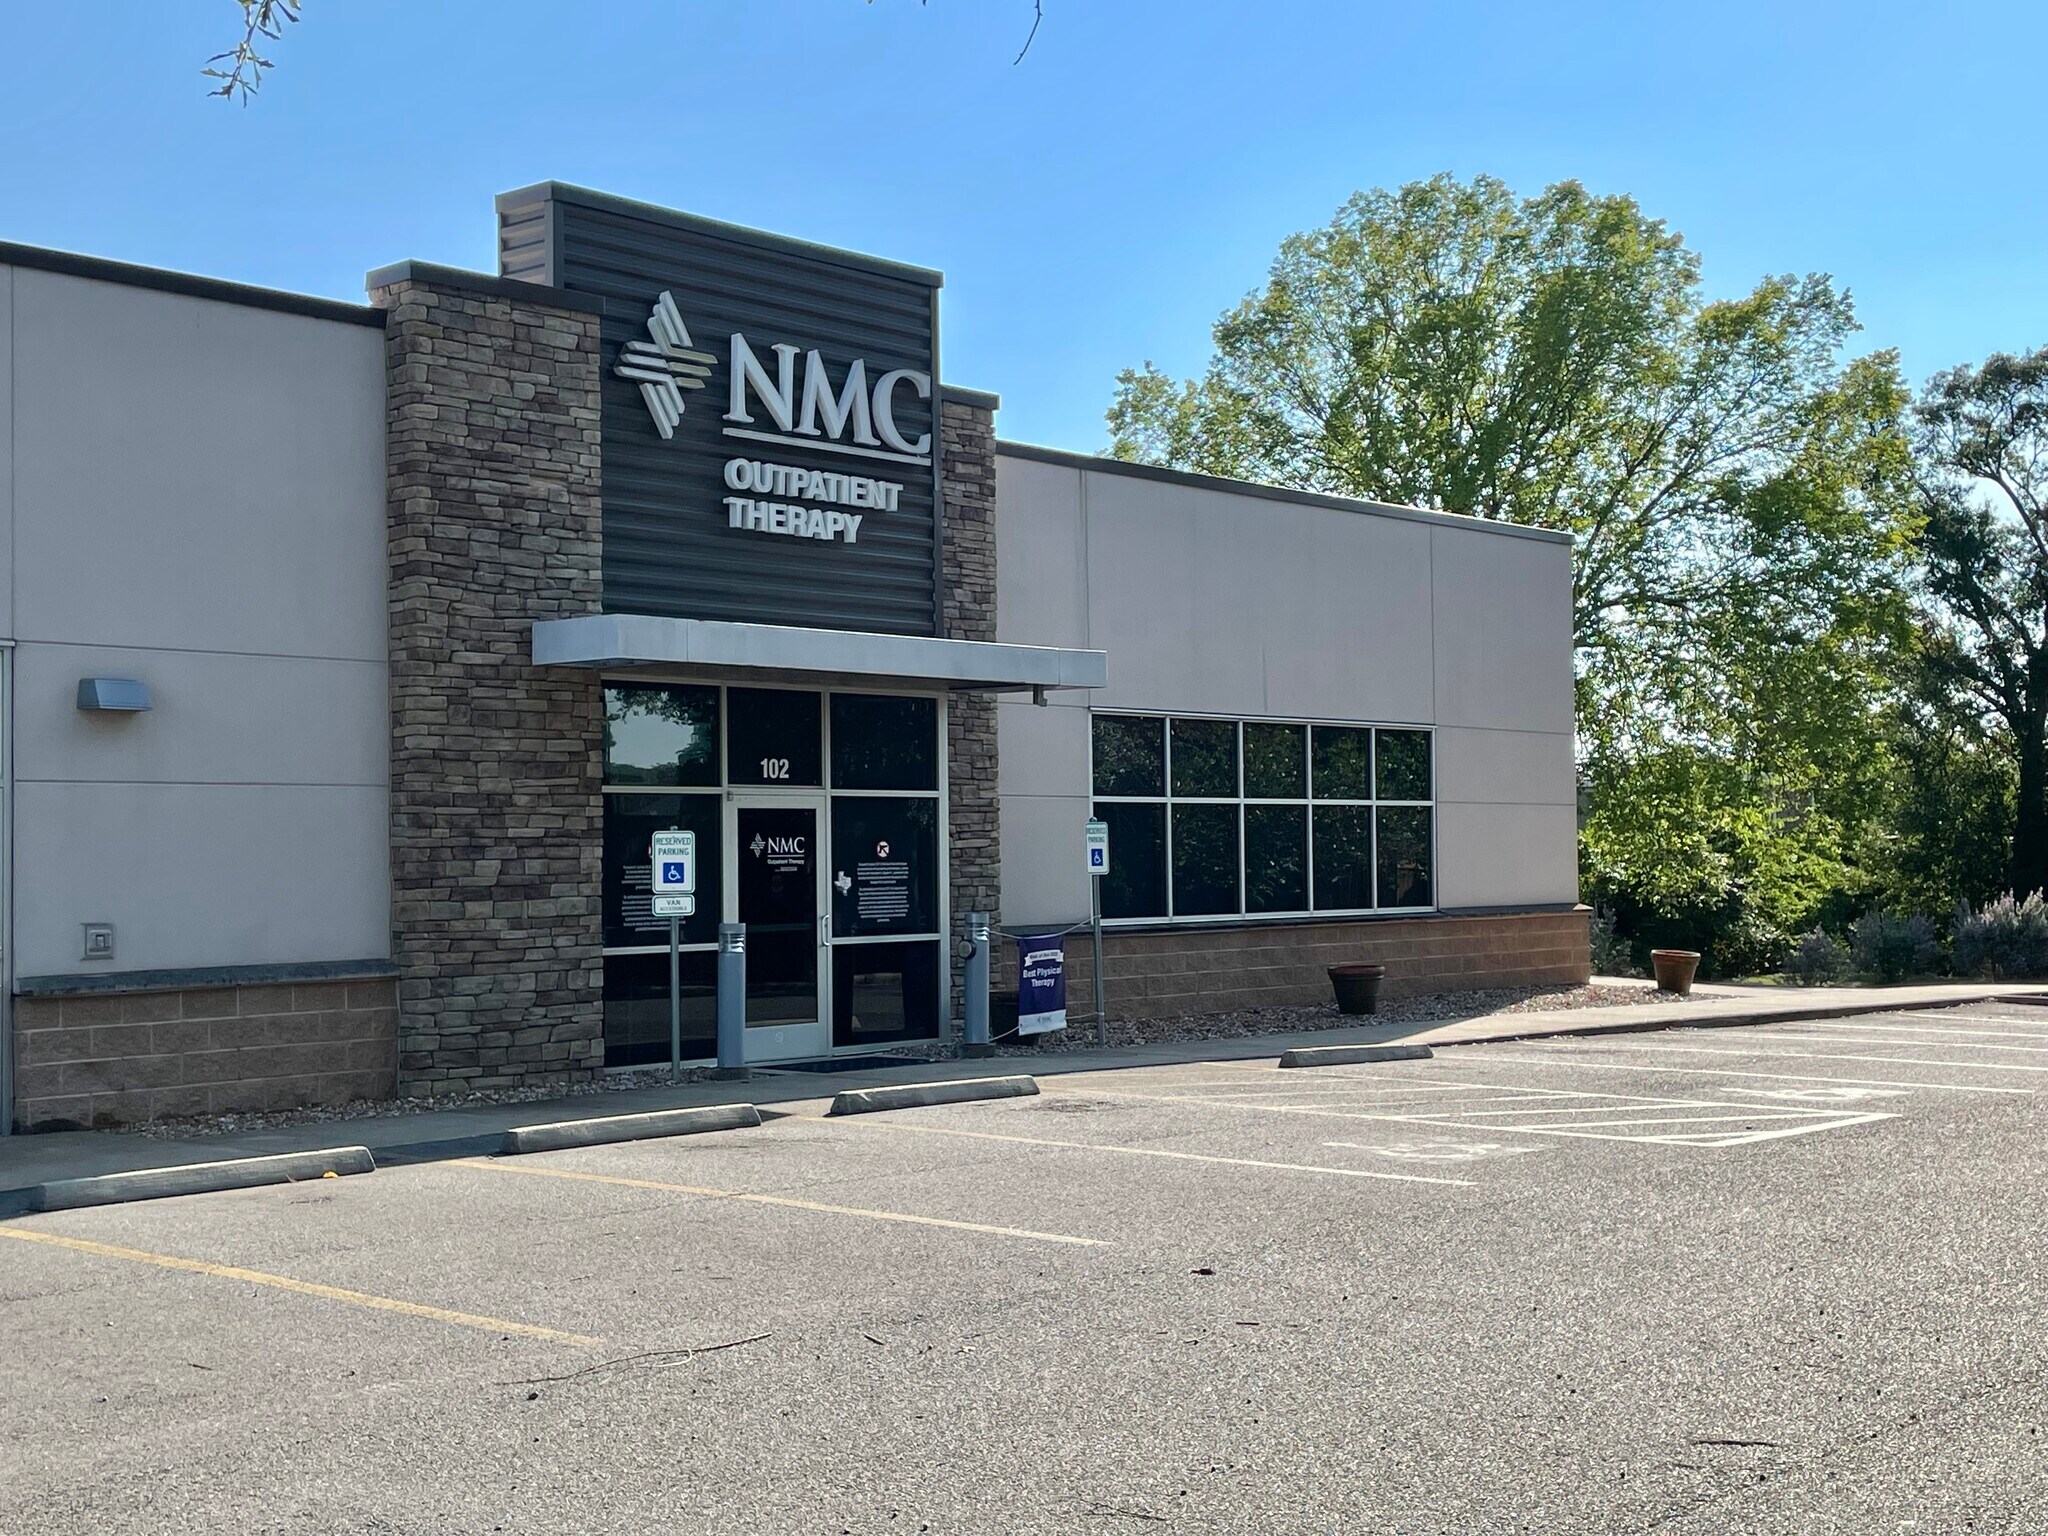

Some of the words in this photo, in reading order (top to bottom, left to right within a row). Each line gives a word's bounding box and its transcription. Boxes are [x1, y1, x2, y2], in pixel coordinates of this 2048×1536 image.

[722, 332, 931, 454] NMC
[724, 458, 903, 511] OUTPATIENT
[723, 497, 862, 543] THERAPY
[760, 758, 789, 778] 102
[656, 837, 691, 845] RESERVED
[767, 837, 804, 853] NMC
[658, 848, 689, 856] PARKING
[1023, 969, 1036, 978] Best
[1037, 966, 1062, 977] Physical
[1031, 979, 1055, 988] Therapy
